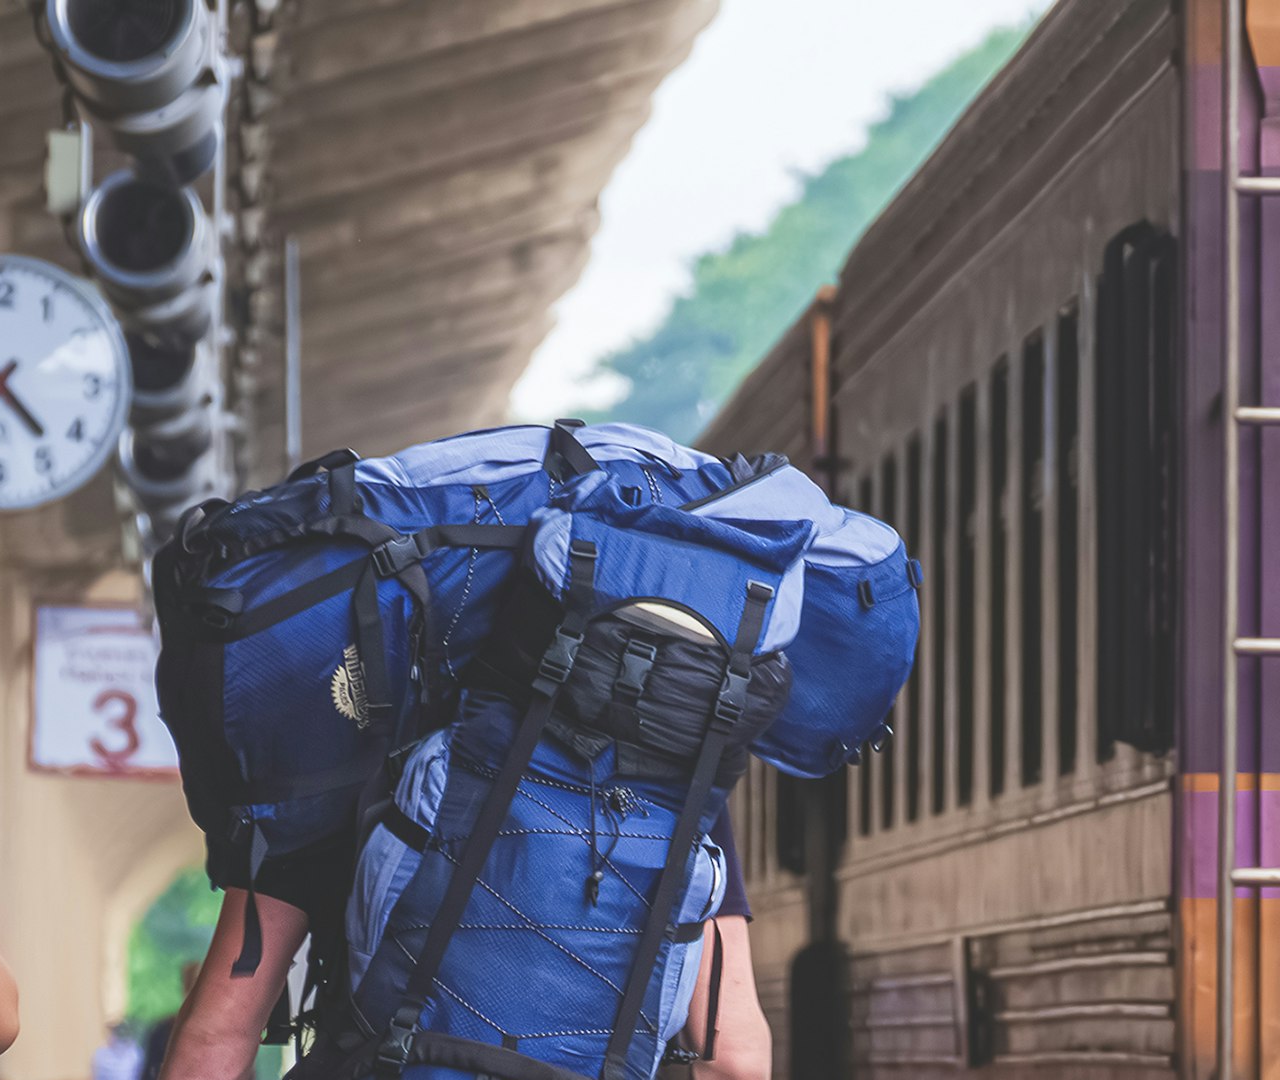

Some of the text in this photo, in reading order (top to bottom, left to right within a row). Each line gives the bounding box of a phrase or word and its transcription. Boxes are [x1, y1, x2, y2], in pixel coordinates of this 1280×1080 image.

[41, 296, 53, 322] 1
[67, 418, 83, 442] 4
[90, 688, 141, 761] 3
